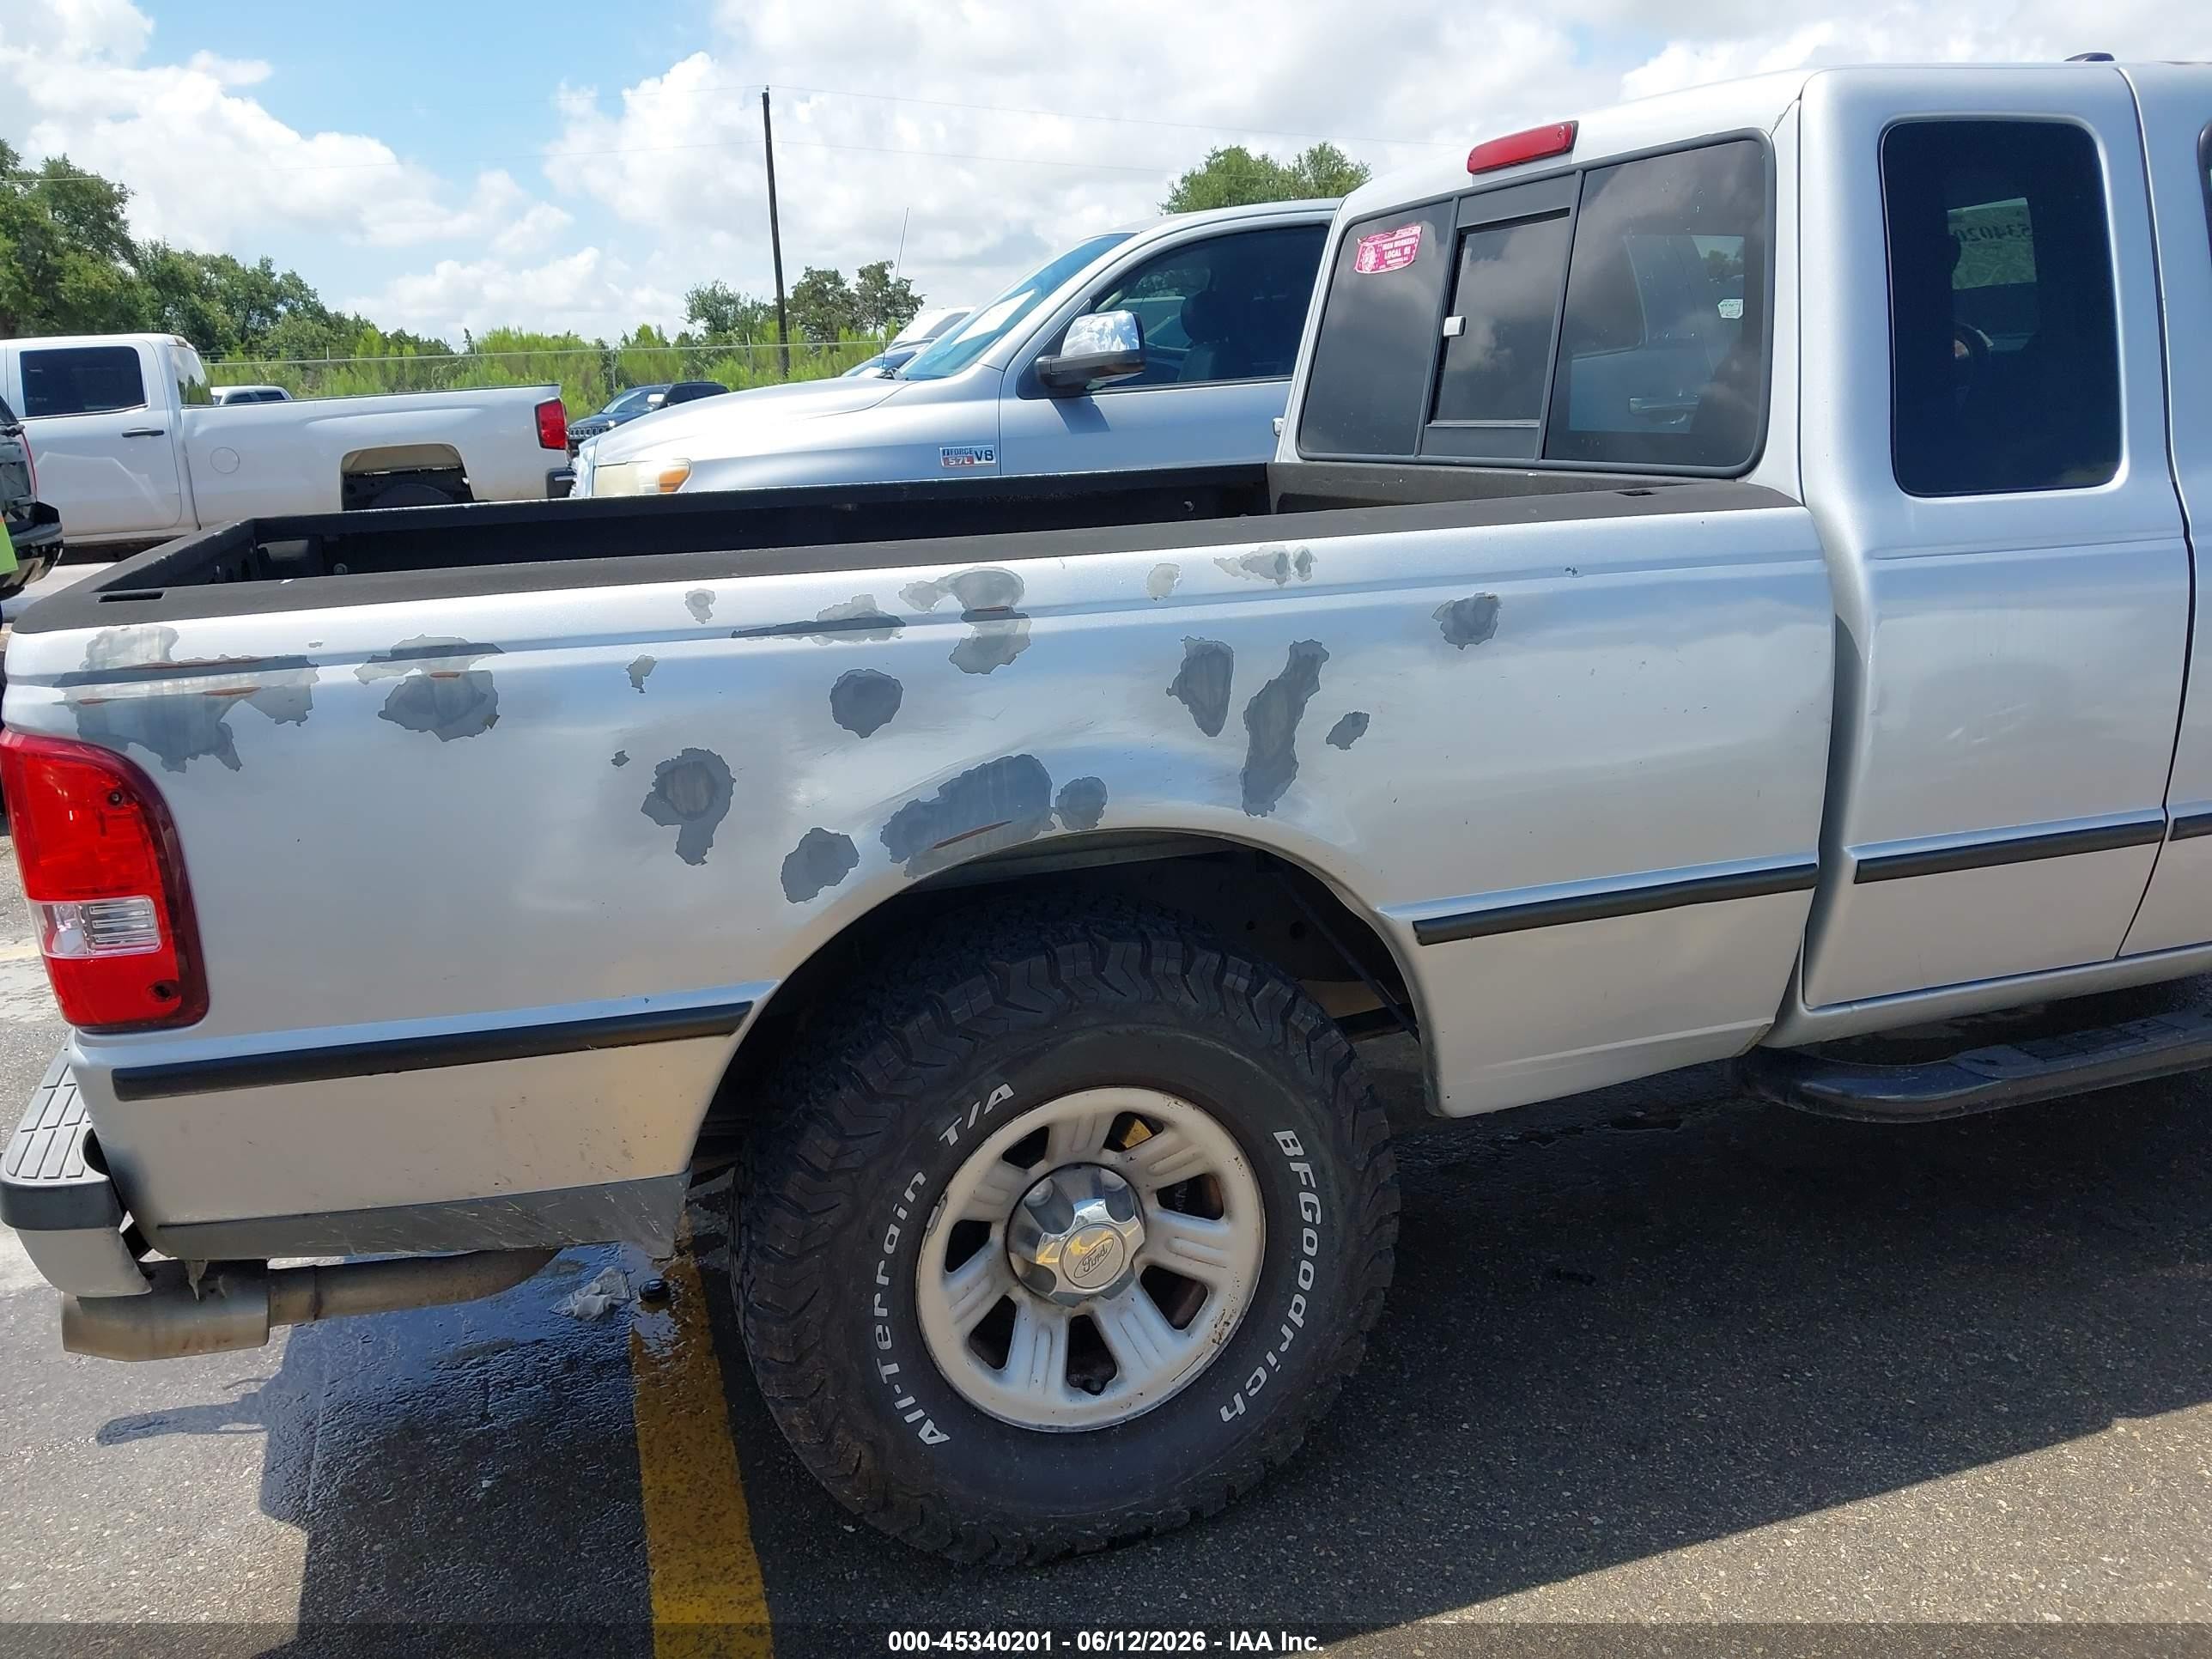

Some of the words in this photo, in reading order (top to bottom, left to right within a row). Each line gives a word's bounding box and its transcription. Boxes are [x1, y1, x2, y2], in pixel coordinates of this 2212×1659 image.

[1384, 247, 1402, 260] LOCAL
[974, 449, 994, 461] V8
[873, 1171, 951, 1445] All-Terrain
[938, 1082, 1015, 1146] T/A
[1219, 1130, 1322, 1423] BFGoodrich
